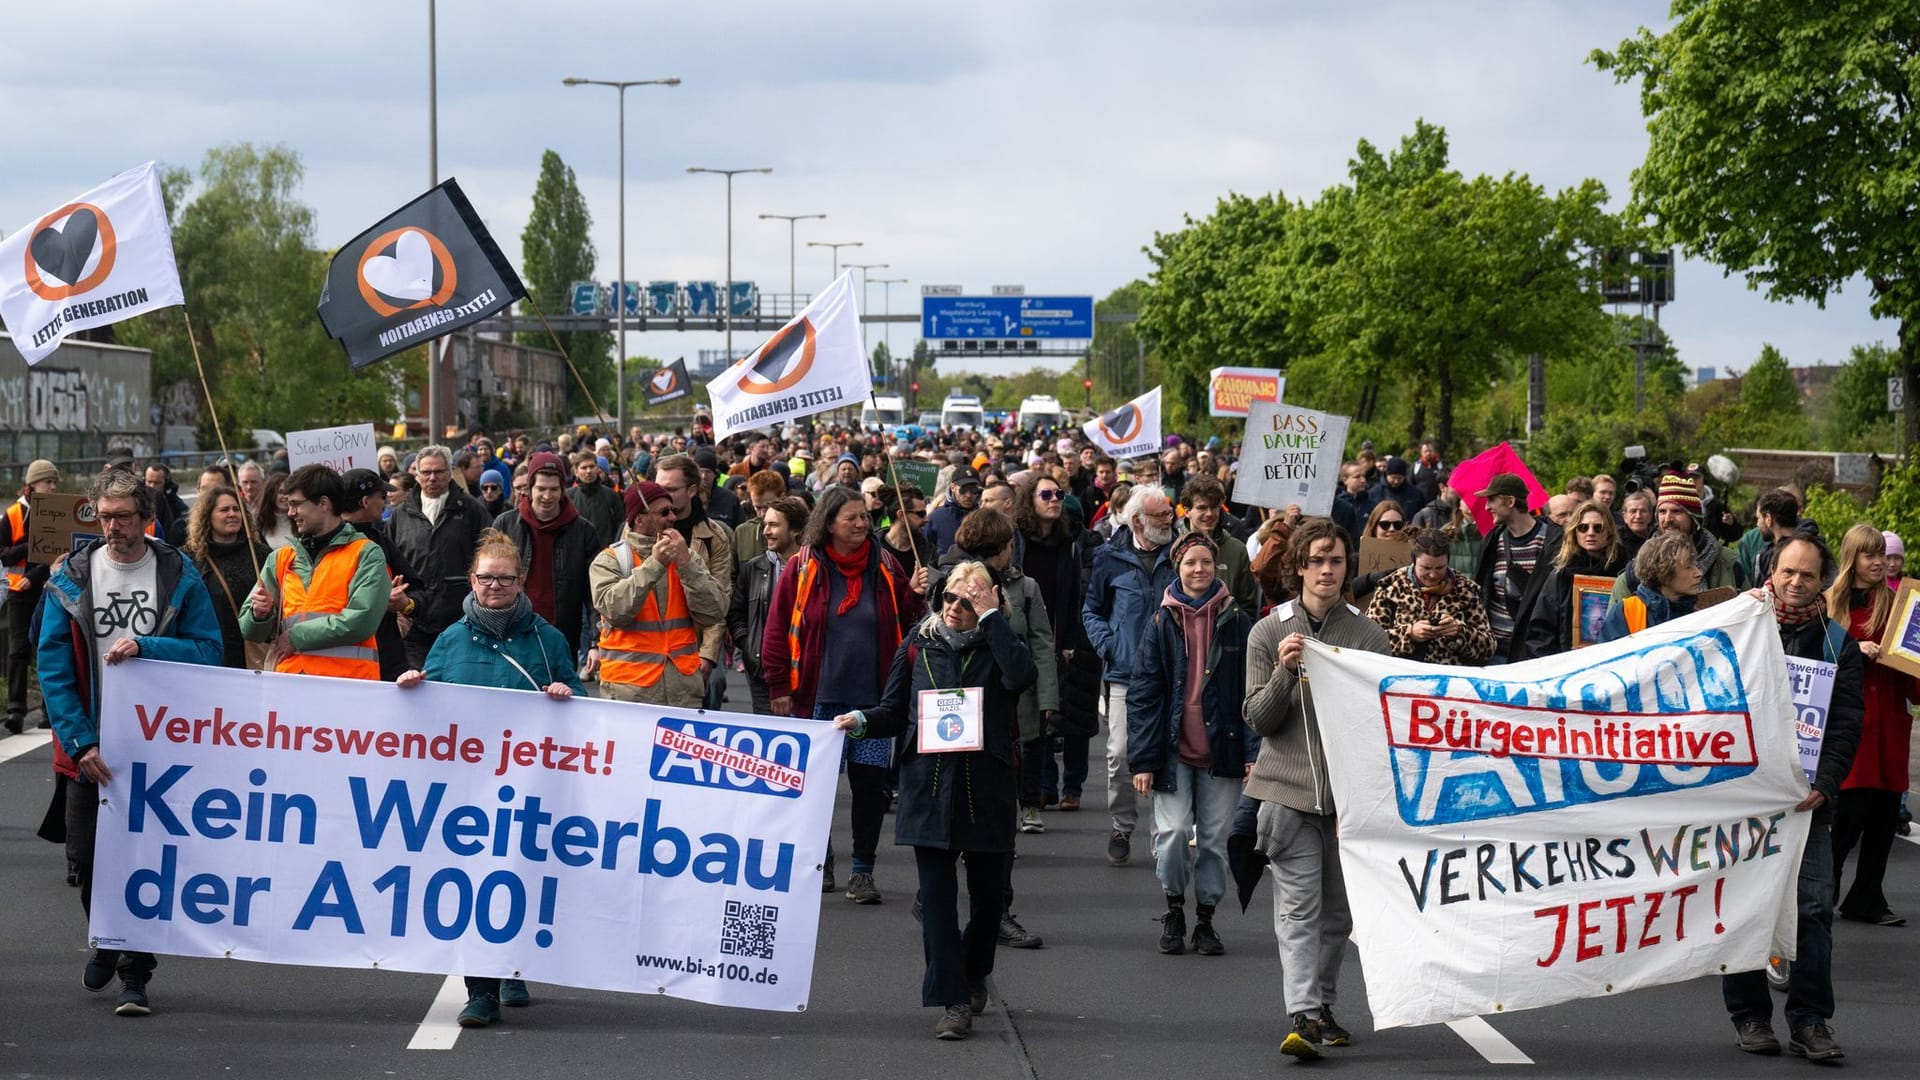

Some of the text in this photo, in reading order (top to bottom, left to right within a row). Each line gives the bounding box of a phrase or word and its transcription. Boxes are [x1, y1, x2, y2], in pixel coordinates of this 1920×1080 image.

[32, 287, 149, 348] LETZTE GENERATION
[333, 431, 369, 451] ÖPNV
[1273, 414, 1318, 434] BASS
[1264, 464, 1317, 480] BETON
[1281, 452, 1314, 465] STATT
[33, 497, 66, 522] Tempo
[1786, 661, 1834, 678] rswende
[135, 704, 615, 776] Verkehrswende jetzt!
[1408, 699, 1735, 760] Bürgerinitiative
[657, 723, 801, 792] A100
[661, 730, 802, 788] Bürgerinitiative
[128, 762, 795, 893] Kein Weiterbau
[125, 844, 558, 948] der A100!
[636, 954, 779, 985] www.bi-a100.de
